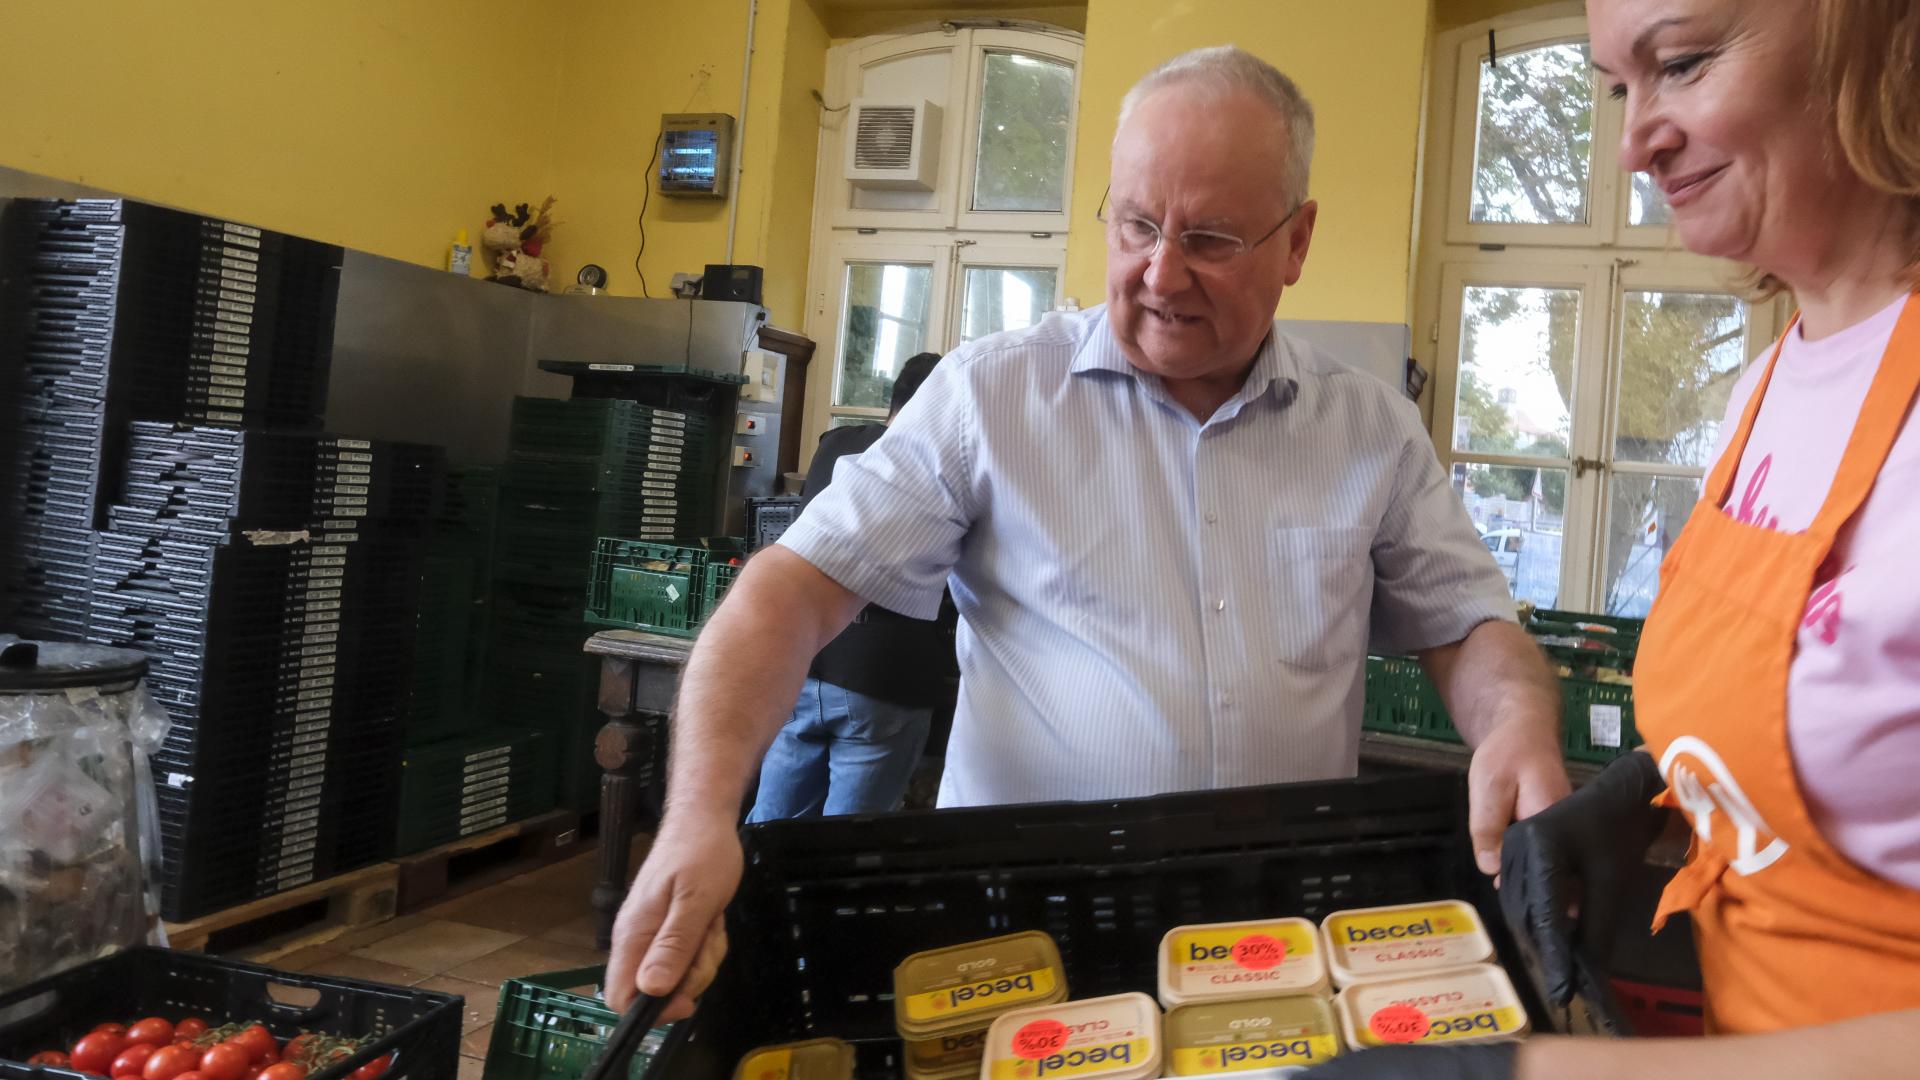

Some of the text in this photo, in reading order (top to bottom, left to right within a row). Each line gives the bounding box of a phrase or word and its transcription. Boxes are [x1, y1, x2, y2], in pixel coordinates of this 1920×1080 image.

[1347, 918, 1434, 942] becel
[1238, 943, 1279, 956] 30%
[1375, 948, 1445, 962] CLASSIC
[957, 958, 997, 972] GOLD
[1210, 971, 1280, 984] CLASSIC
[951, 974, 1034, 1007] becel
[1228, 1017, 1272, 1029] GOLD
[1019, 1035, 1062, 1050] 30%
[1037, 1043, 1132, 1077] becel
[1221, 1039, 1313, 1067] becel
